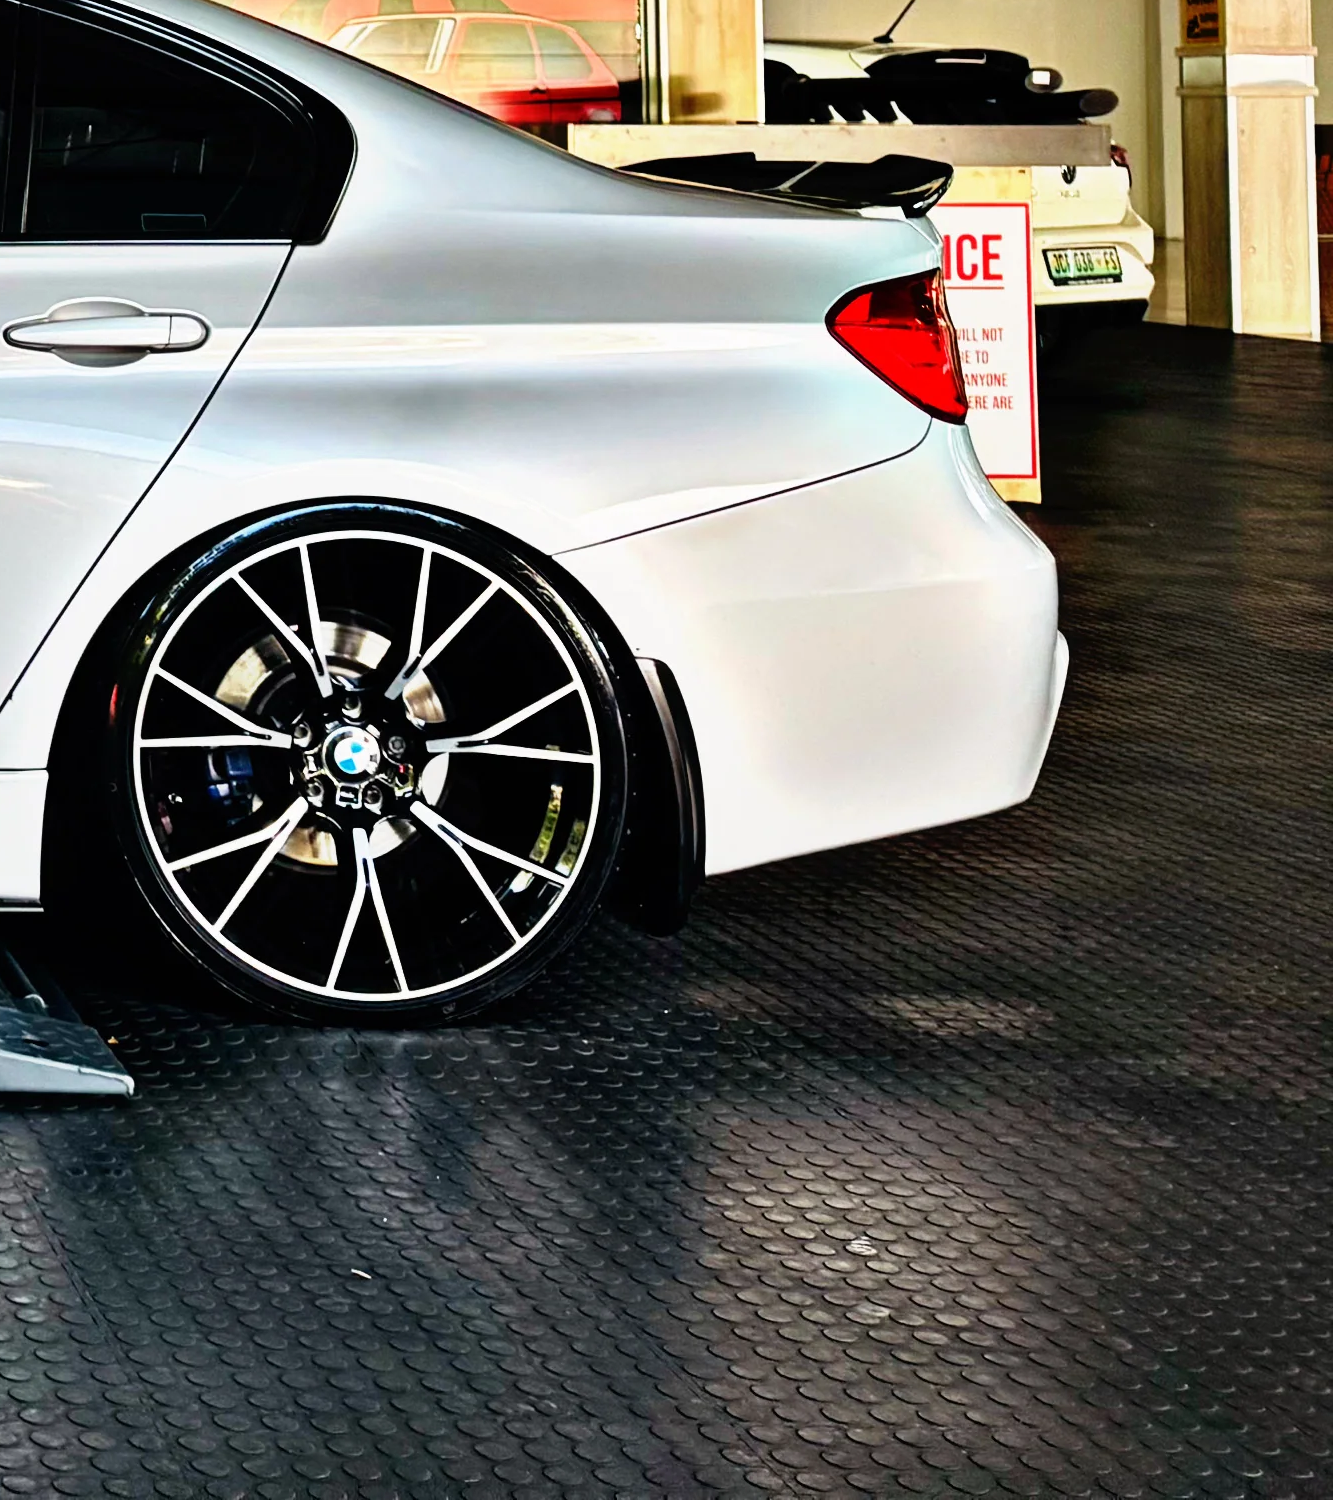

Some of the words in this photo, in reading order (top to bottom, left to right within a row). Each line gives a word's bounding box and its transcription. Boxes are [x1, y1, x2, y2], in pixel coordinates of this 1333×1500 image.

[943, 233, 1003, 281] ICE
[982, 327, 1004, 342] NOT
[975, 350, 989, 365] TO
[965, 373, 1008, 387] ANYONE
[968, 395, 989, 410] ERE
[993, 395, 1013, 410] ARE
